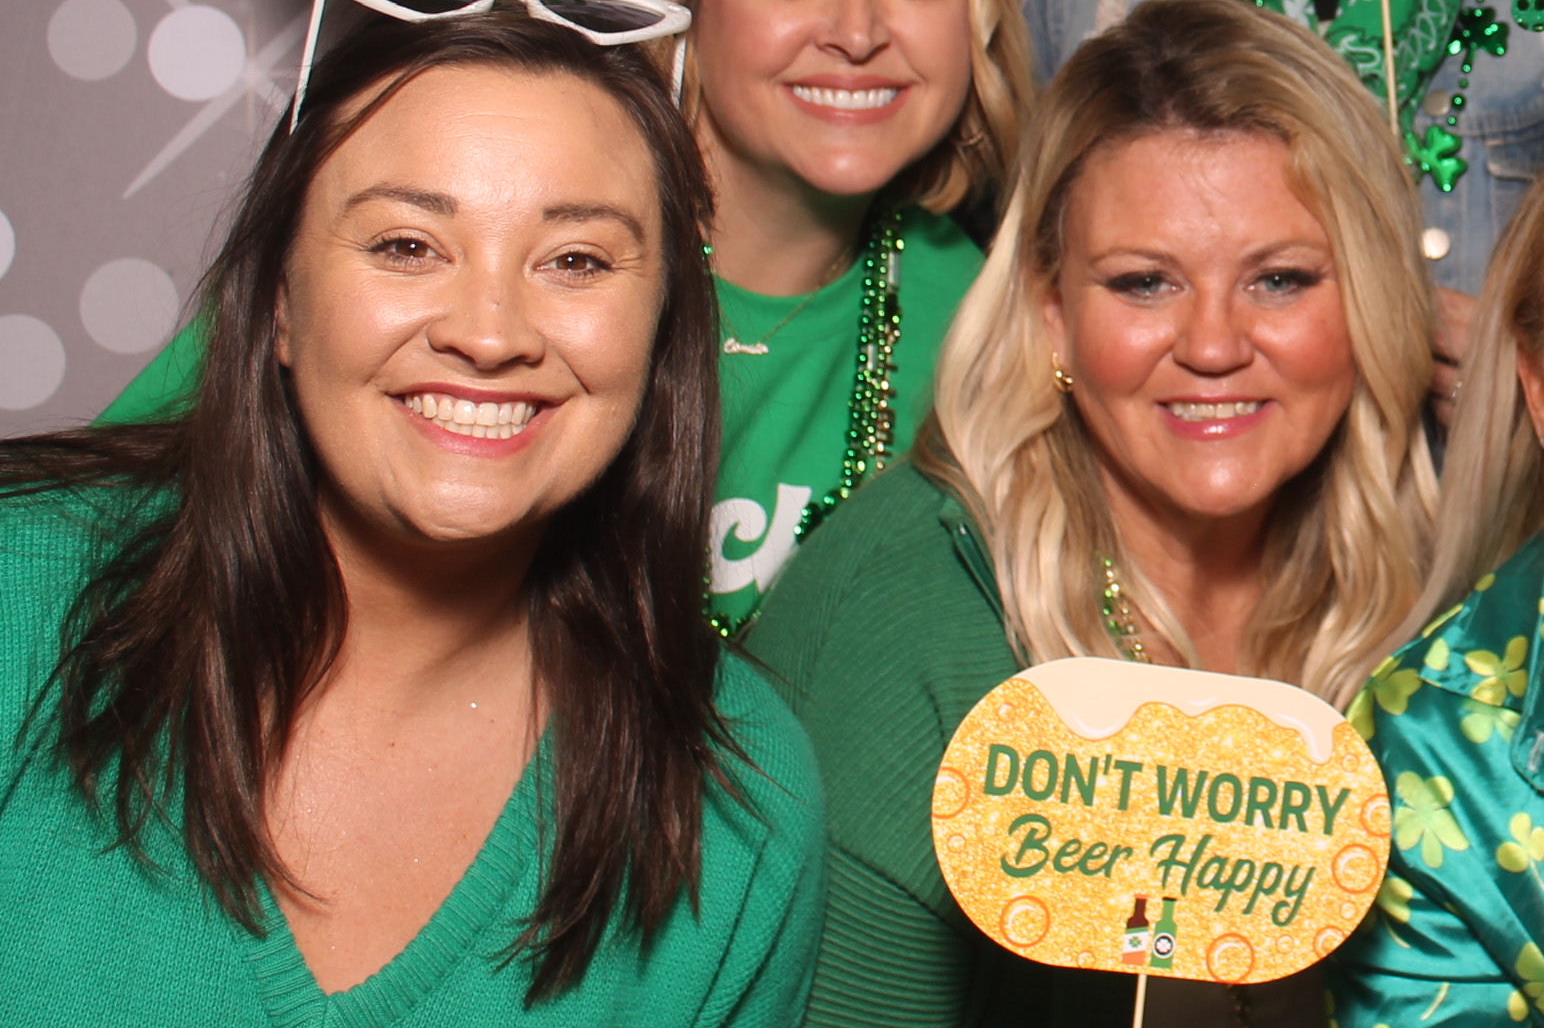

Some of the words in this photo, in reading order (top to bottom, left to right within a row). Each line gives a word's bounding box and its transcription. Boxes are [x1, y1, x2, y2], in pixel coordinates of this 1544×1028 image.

[983, 743, 1144, 812] DON'T
[1155, 765, 1351, 837] WORRY
[1000, 813, 1134, 879] Beer
[1149, 834, 1317, 928] Happy
